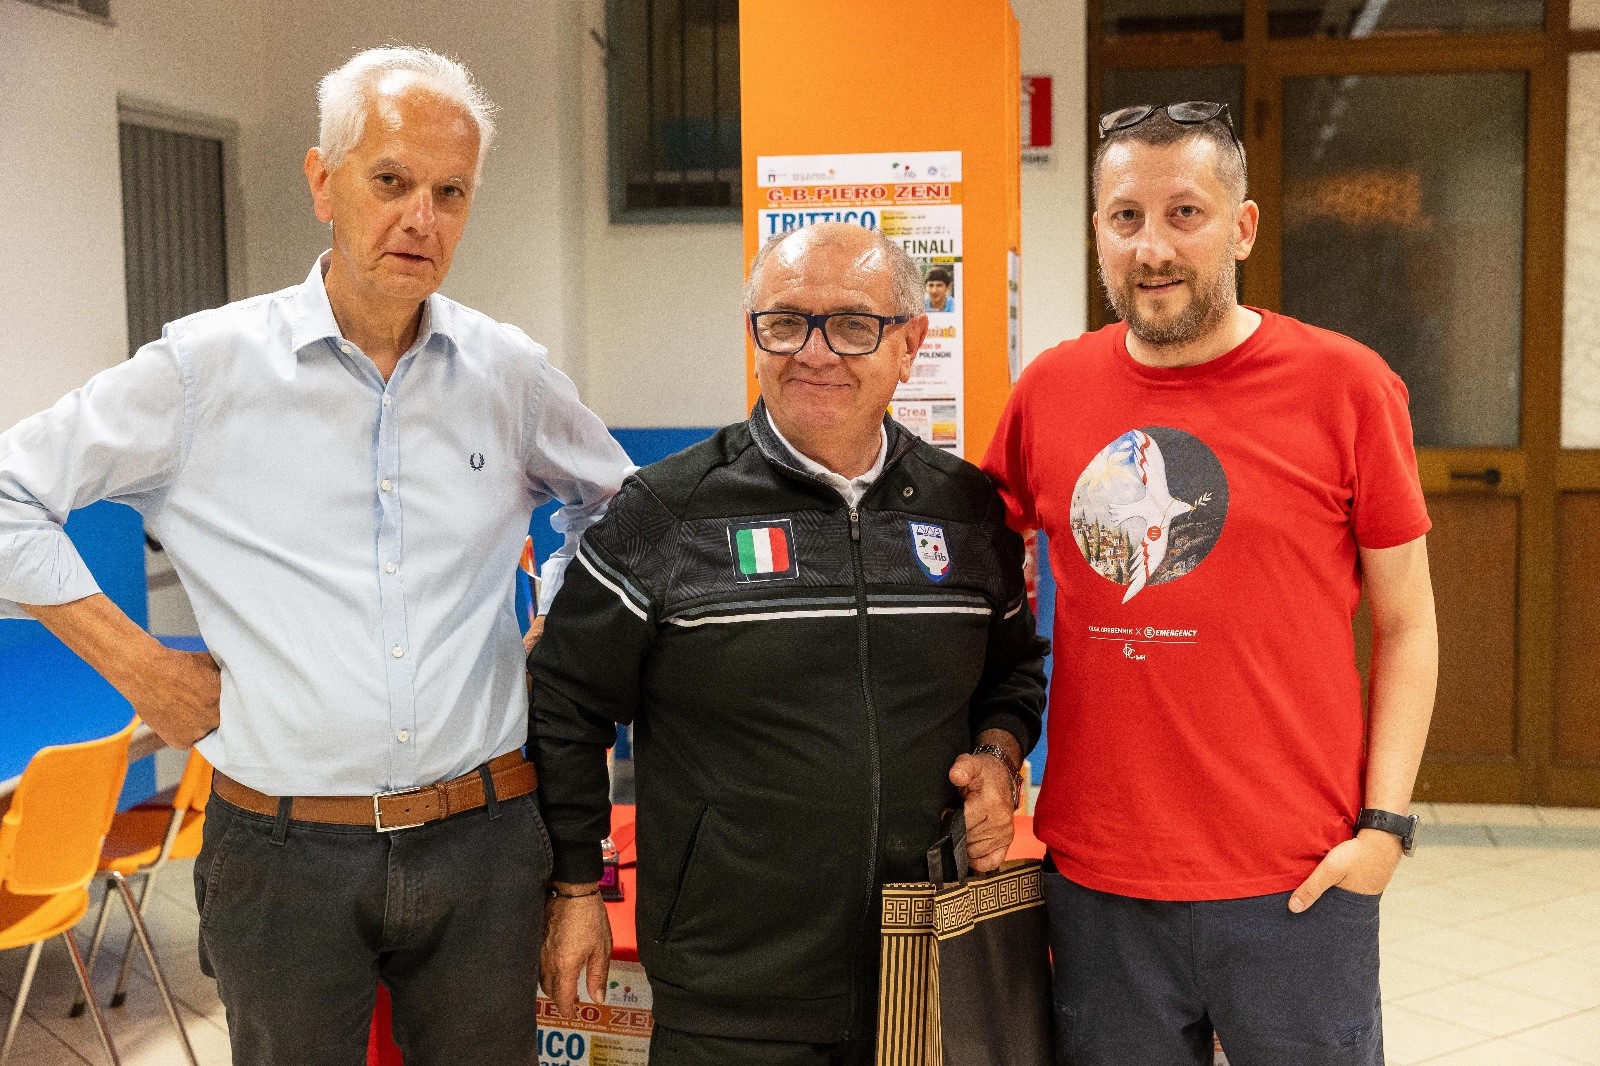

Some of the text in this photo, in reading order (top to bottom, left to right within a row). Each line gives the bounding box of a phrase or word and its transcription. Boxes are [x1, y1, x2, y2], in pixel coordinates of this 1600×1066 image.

[767, 185, 950, 201] G.B.PIERO ZENI
[903, 239, 954, 255] FINALI
[898, 406, 927, 417] Crea
[933, 552, 947, 561] fib
[1155, 629, 1198, 637] EMERGENCY
